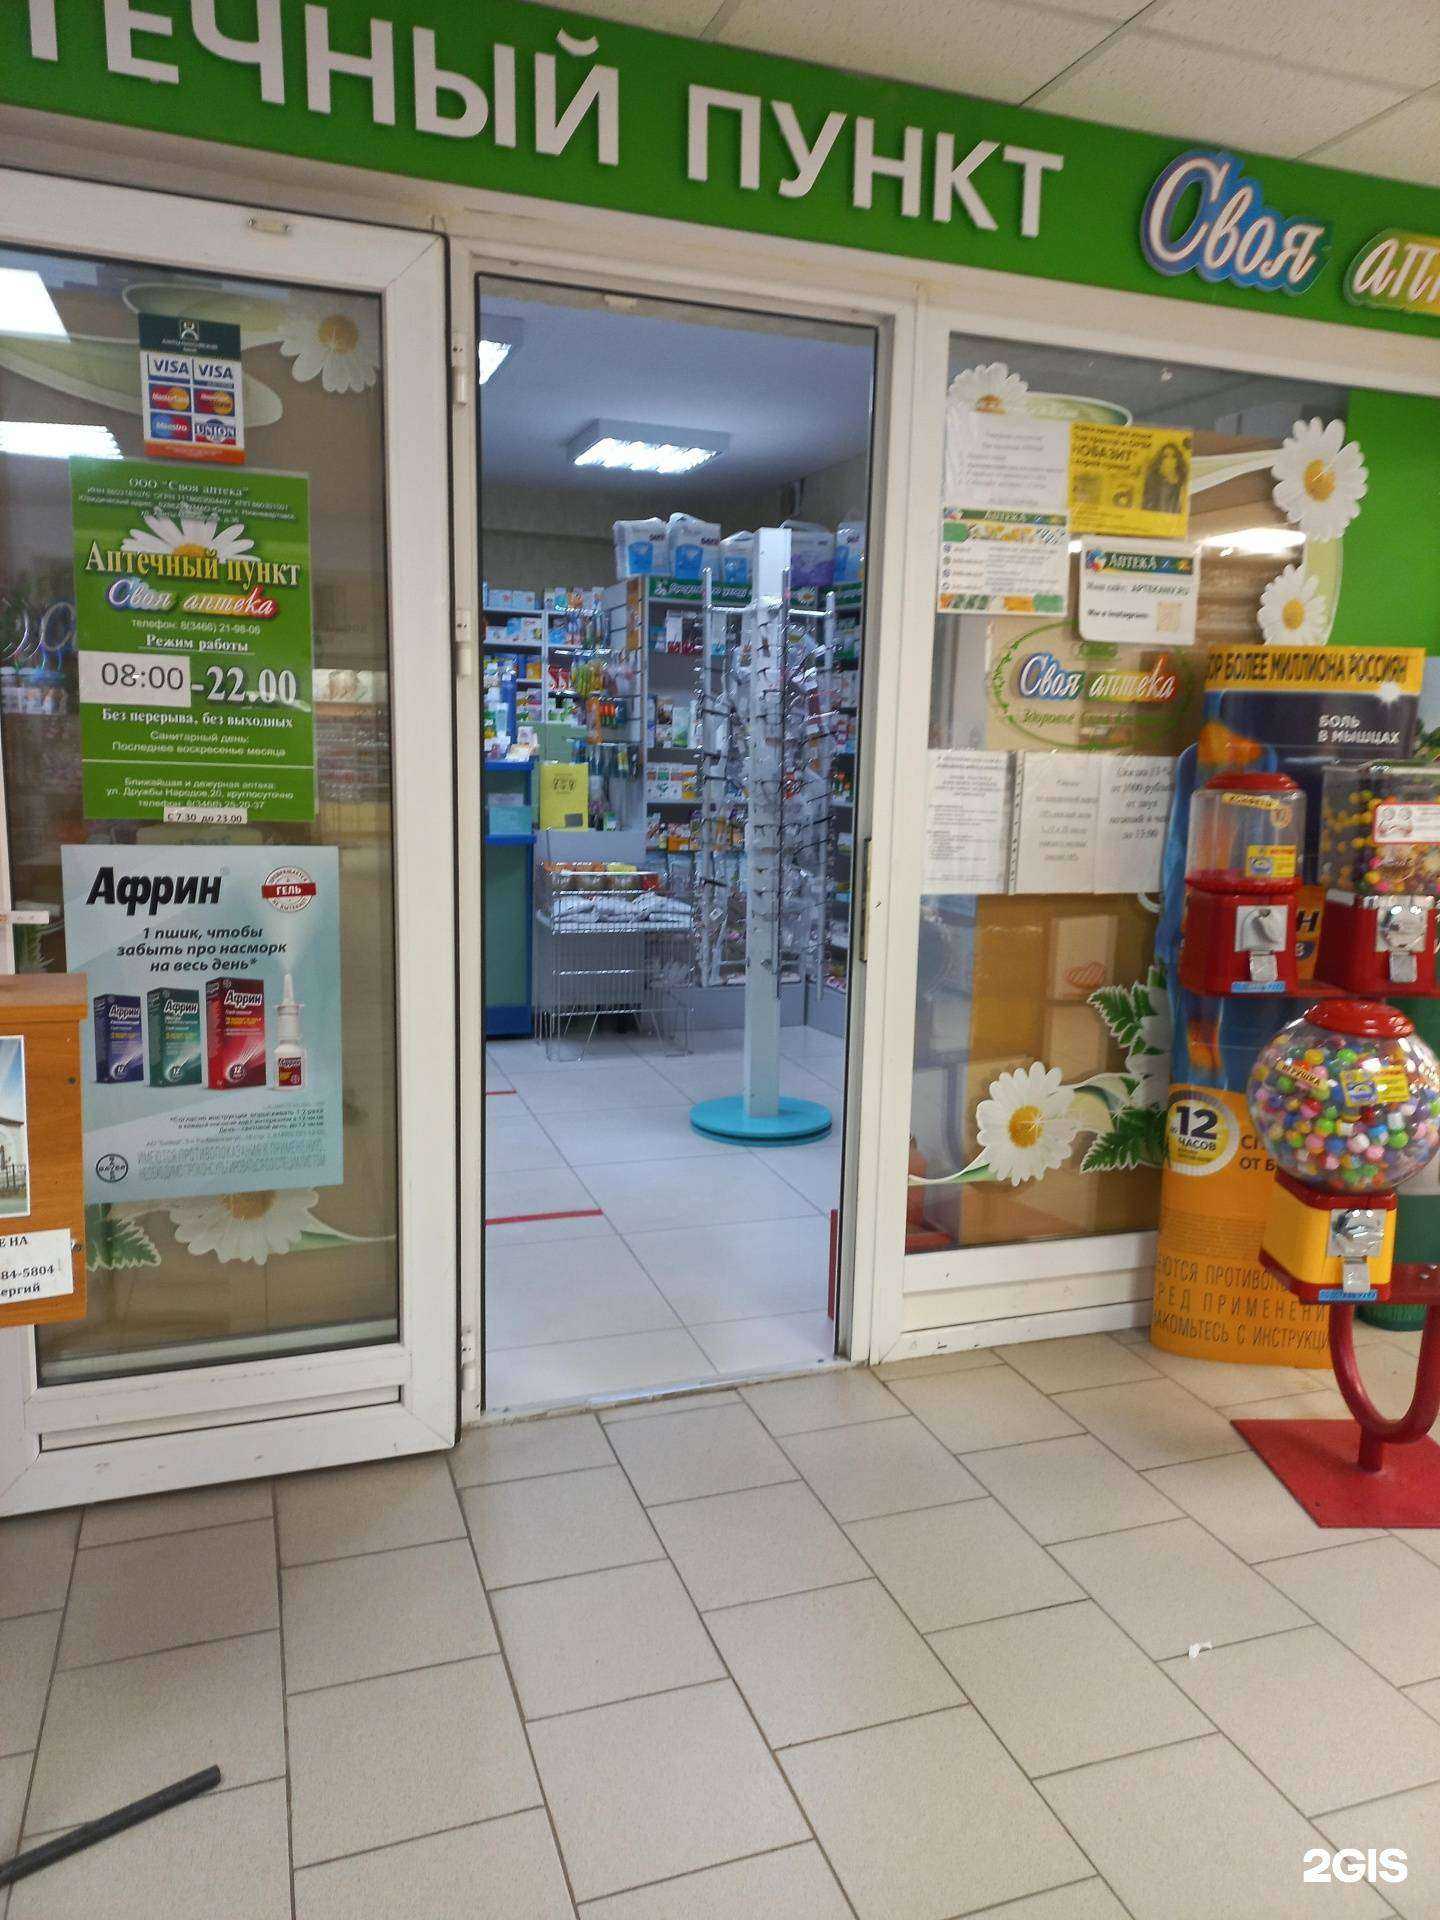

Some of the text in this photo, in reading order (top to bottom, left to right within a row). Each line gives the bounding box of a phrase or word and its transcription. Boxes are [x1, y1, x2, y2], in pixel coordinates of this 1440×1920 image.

[688, 83, 1064, 238] ПУНКТ
[1149, 157, 1440, 303] Своя ап
[154, 359, 234, 379] VISA VISA
[85, 541, 301, 591] Аптечный пункт
[108, 578, 276, 616] Своя аптека
[146, 633, 249, 653] Режим работы
[1019, 654, 1177, 699] Своя аптека
[1225, 652, 1269, 680] БОЛЕЕ
[1272, 653, 1346, 682] МИЛЛИОНА
[102, 708, 126, 721] Без
[202, 712, 224, 725] без
[227, 715, 294, 729] выходных
[1318, 714, 1361, 729] БОЛЬ
[1318, 730, 1400, 746] В МЫШЦАХ
[86, 866, 222, 916] Африн
[276, 884, 302, 897] ГЕЛЬ
[143, 925, 263, 941] 1 пшик, чтобы
[116, 943, 287, 957] забыть про насморк
[150, 961, 169, 972] на
[174, 961, 208, 972] весь
[224, 989, 263, 1007] Африн
[109, 1004, 141, 1018] Африн
[163, 1000, 199, 1016] Африн
[1176, 1105, 1219, 1140] 12
[1178, 1136, 1217, 1152] ЧАСОВ
[1240, 1156, 1261, 1171] ОТ
[0, 1282, 41, 1299] ергий
[1236, 1323, 1246, 1345] С
